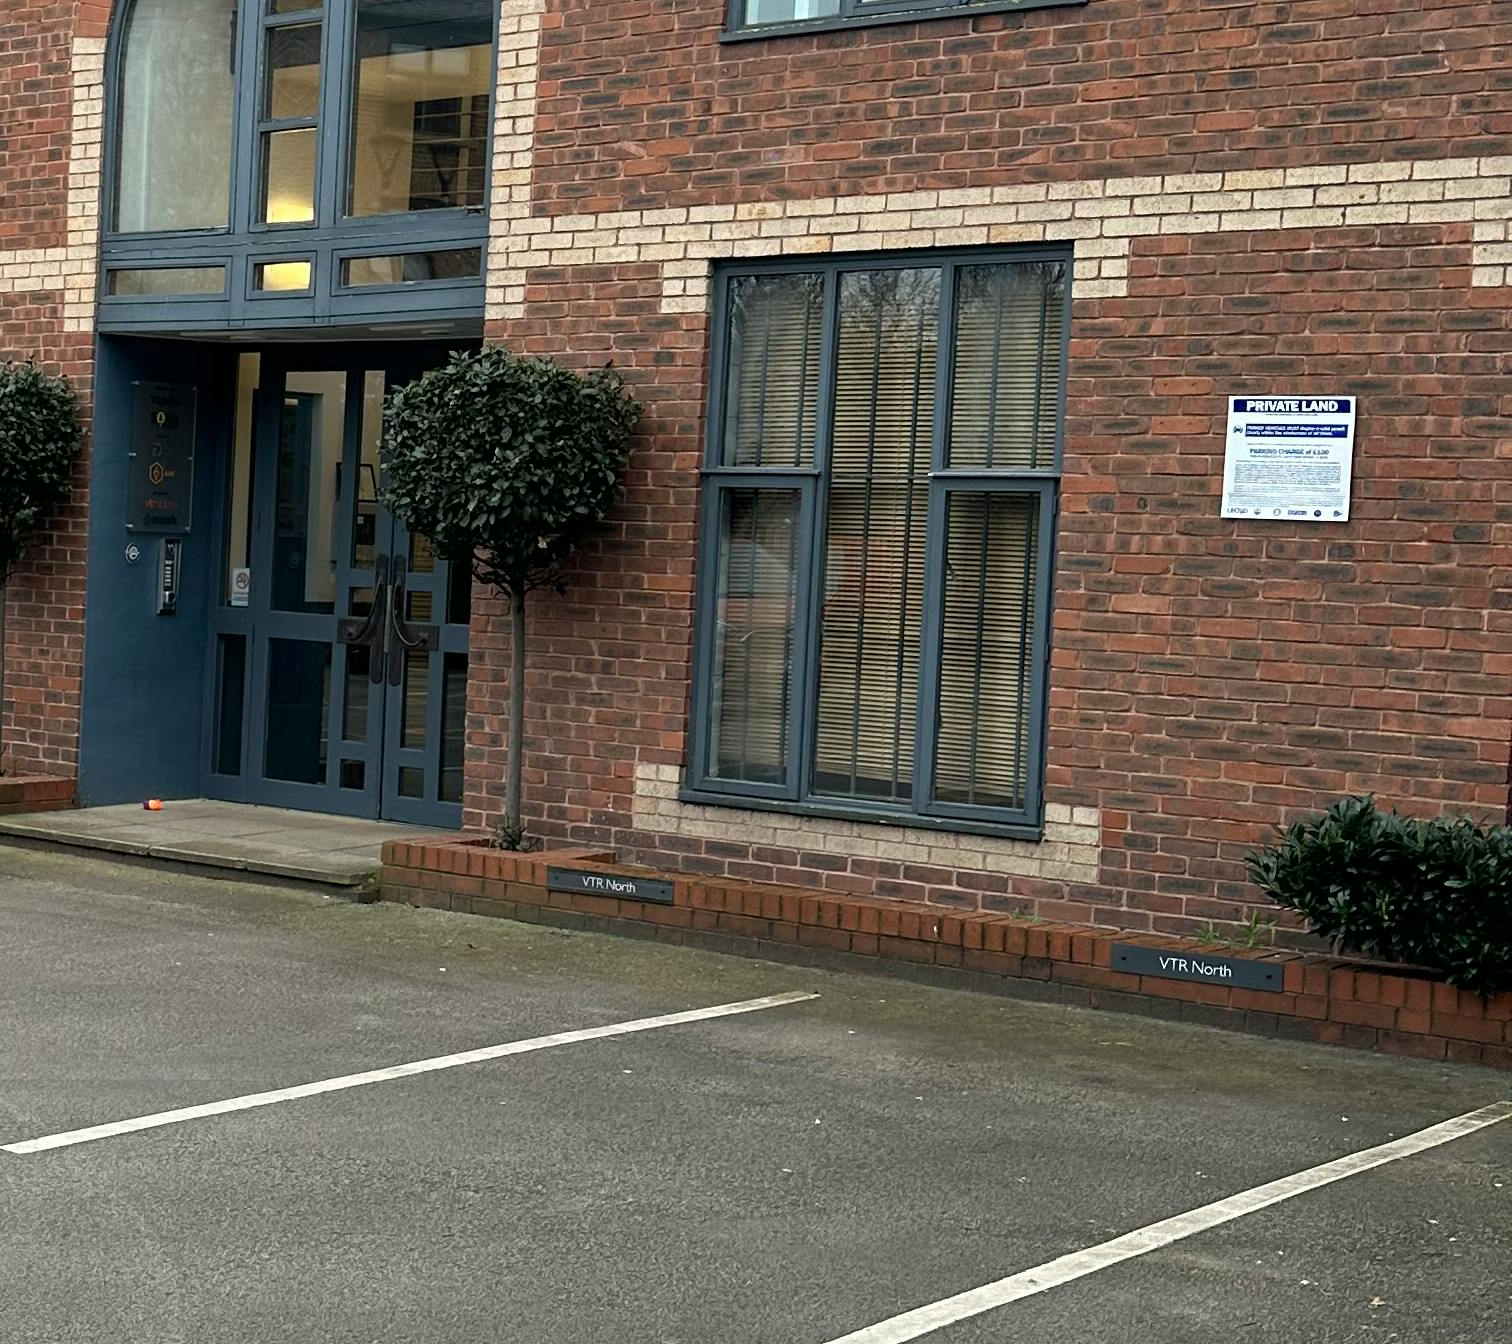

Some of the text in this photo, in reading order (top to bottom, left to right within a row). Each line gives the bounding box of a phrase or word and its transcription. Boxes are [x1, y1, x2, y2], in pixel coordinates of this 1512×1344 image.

[1246, 400, 1339, 412] PRIVATE LAND
[582, 876, 636, 893] VTR North
[1159, 956, 1232, 978] VTR North
